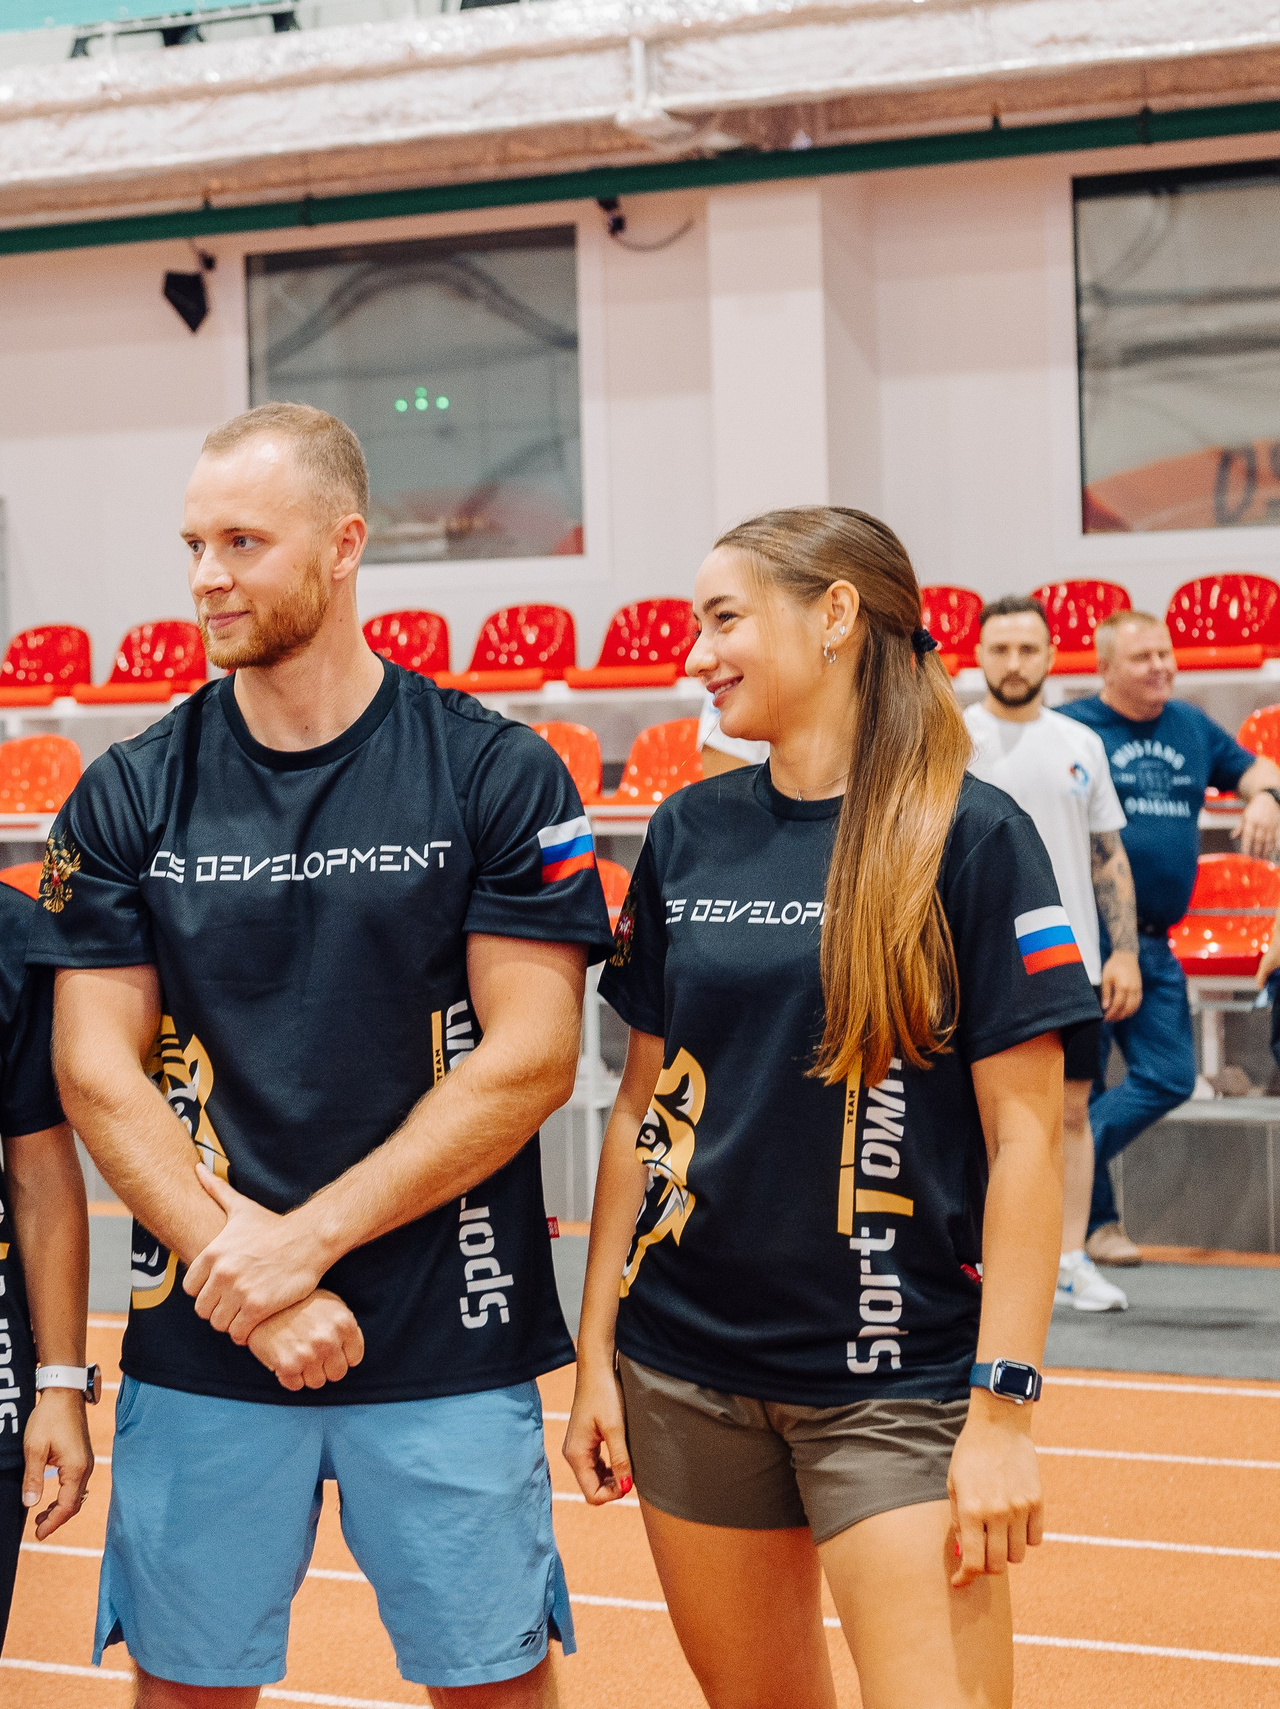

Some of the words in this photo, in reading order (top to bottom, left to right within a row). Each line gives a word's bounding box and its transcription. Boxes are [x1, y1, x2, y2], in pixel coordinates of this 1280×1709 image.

[1124, 796, 1191, 818] ORIGINAL
[149, 850, 186, 883] CS
[195, 840, 452, 882] DEVELOPMENT
[690, 898, 825, 926] DEVELOP
[435, 1048, 444, 1082] TEAM
[847, 1090, 856, 1124] TEAM
[458, 1196, 514, 1330] Spor
